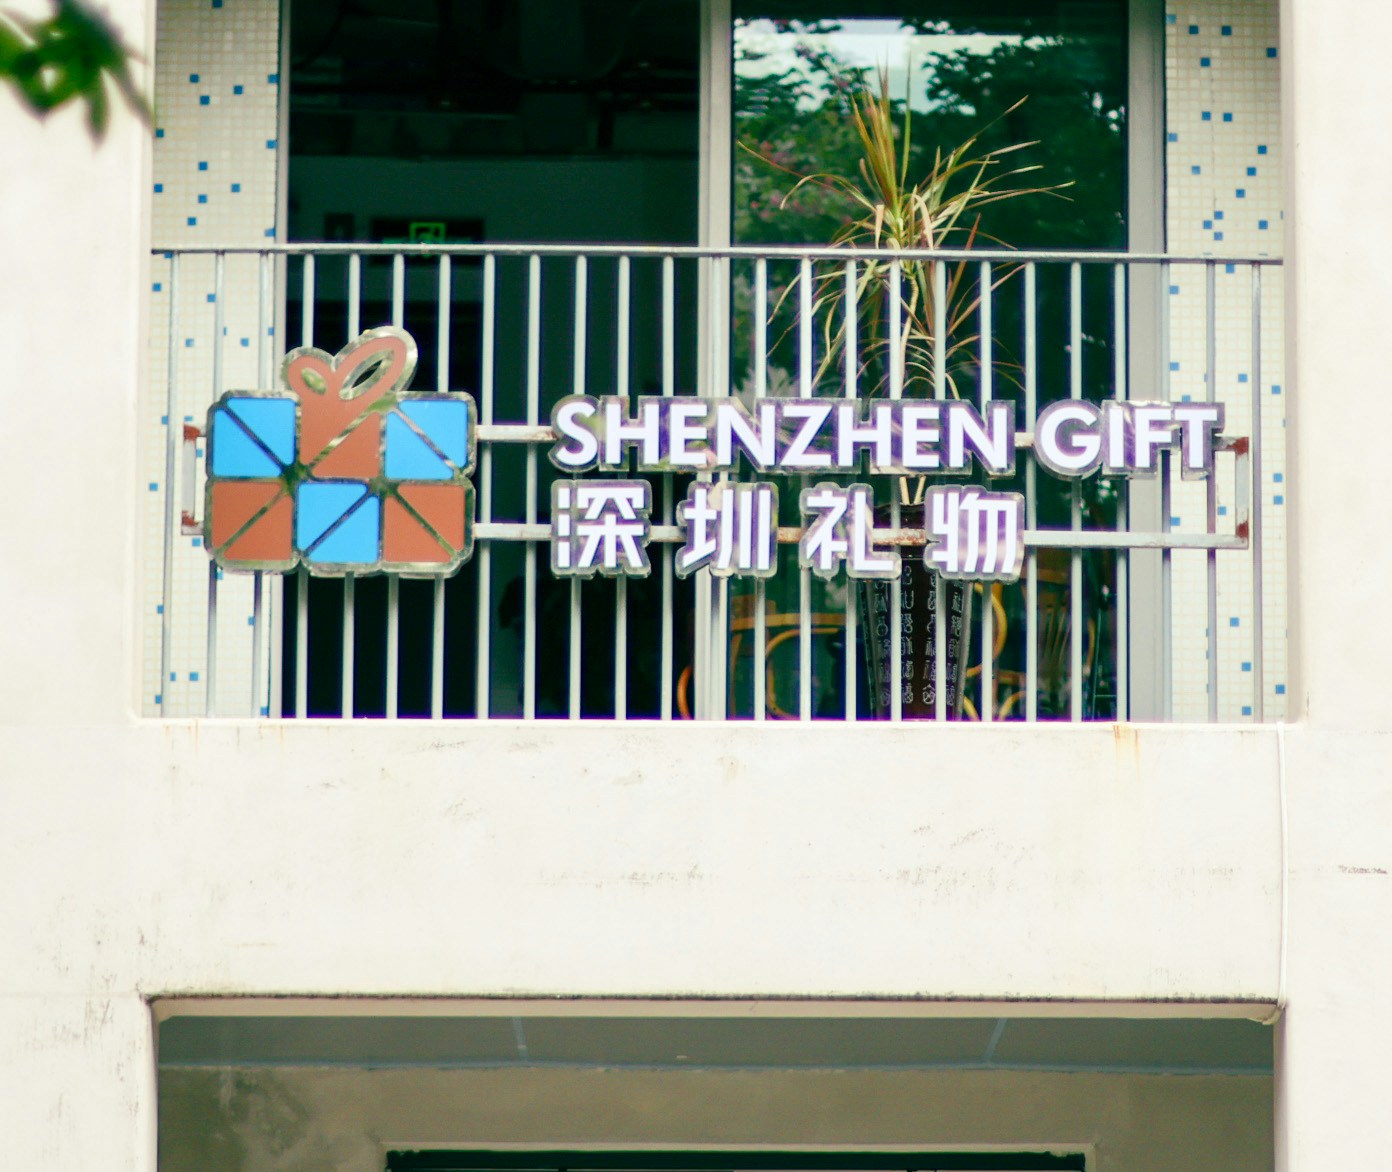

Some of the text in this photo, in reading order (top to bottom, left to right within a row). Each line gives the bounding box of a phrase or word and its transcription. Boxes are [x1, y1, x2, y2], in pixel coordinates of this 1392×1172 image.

[557, 401, 1219, 469] SHENZHEN GIFT
[556, 485, 1024, 575] 深圳礼物
